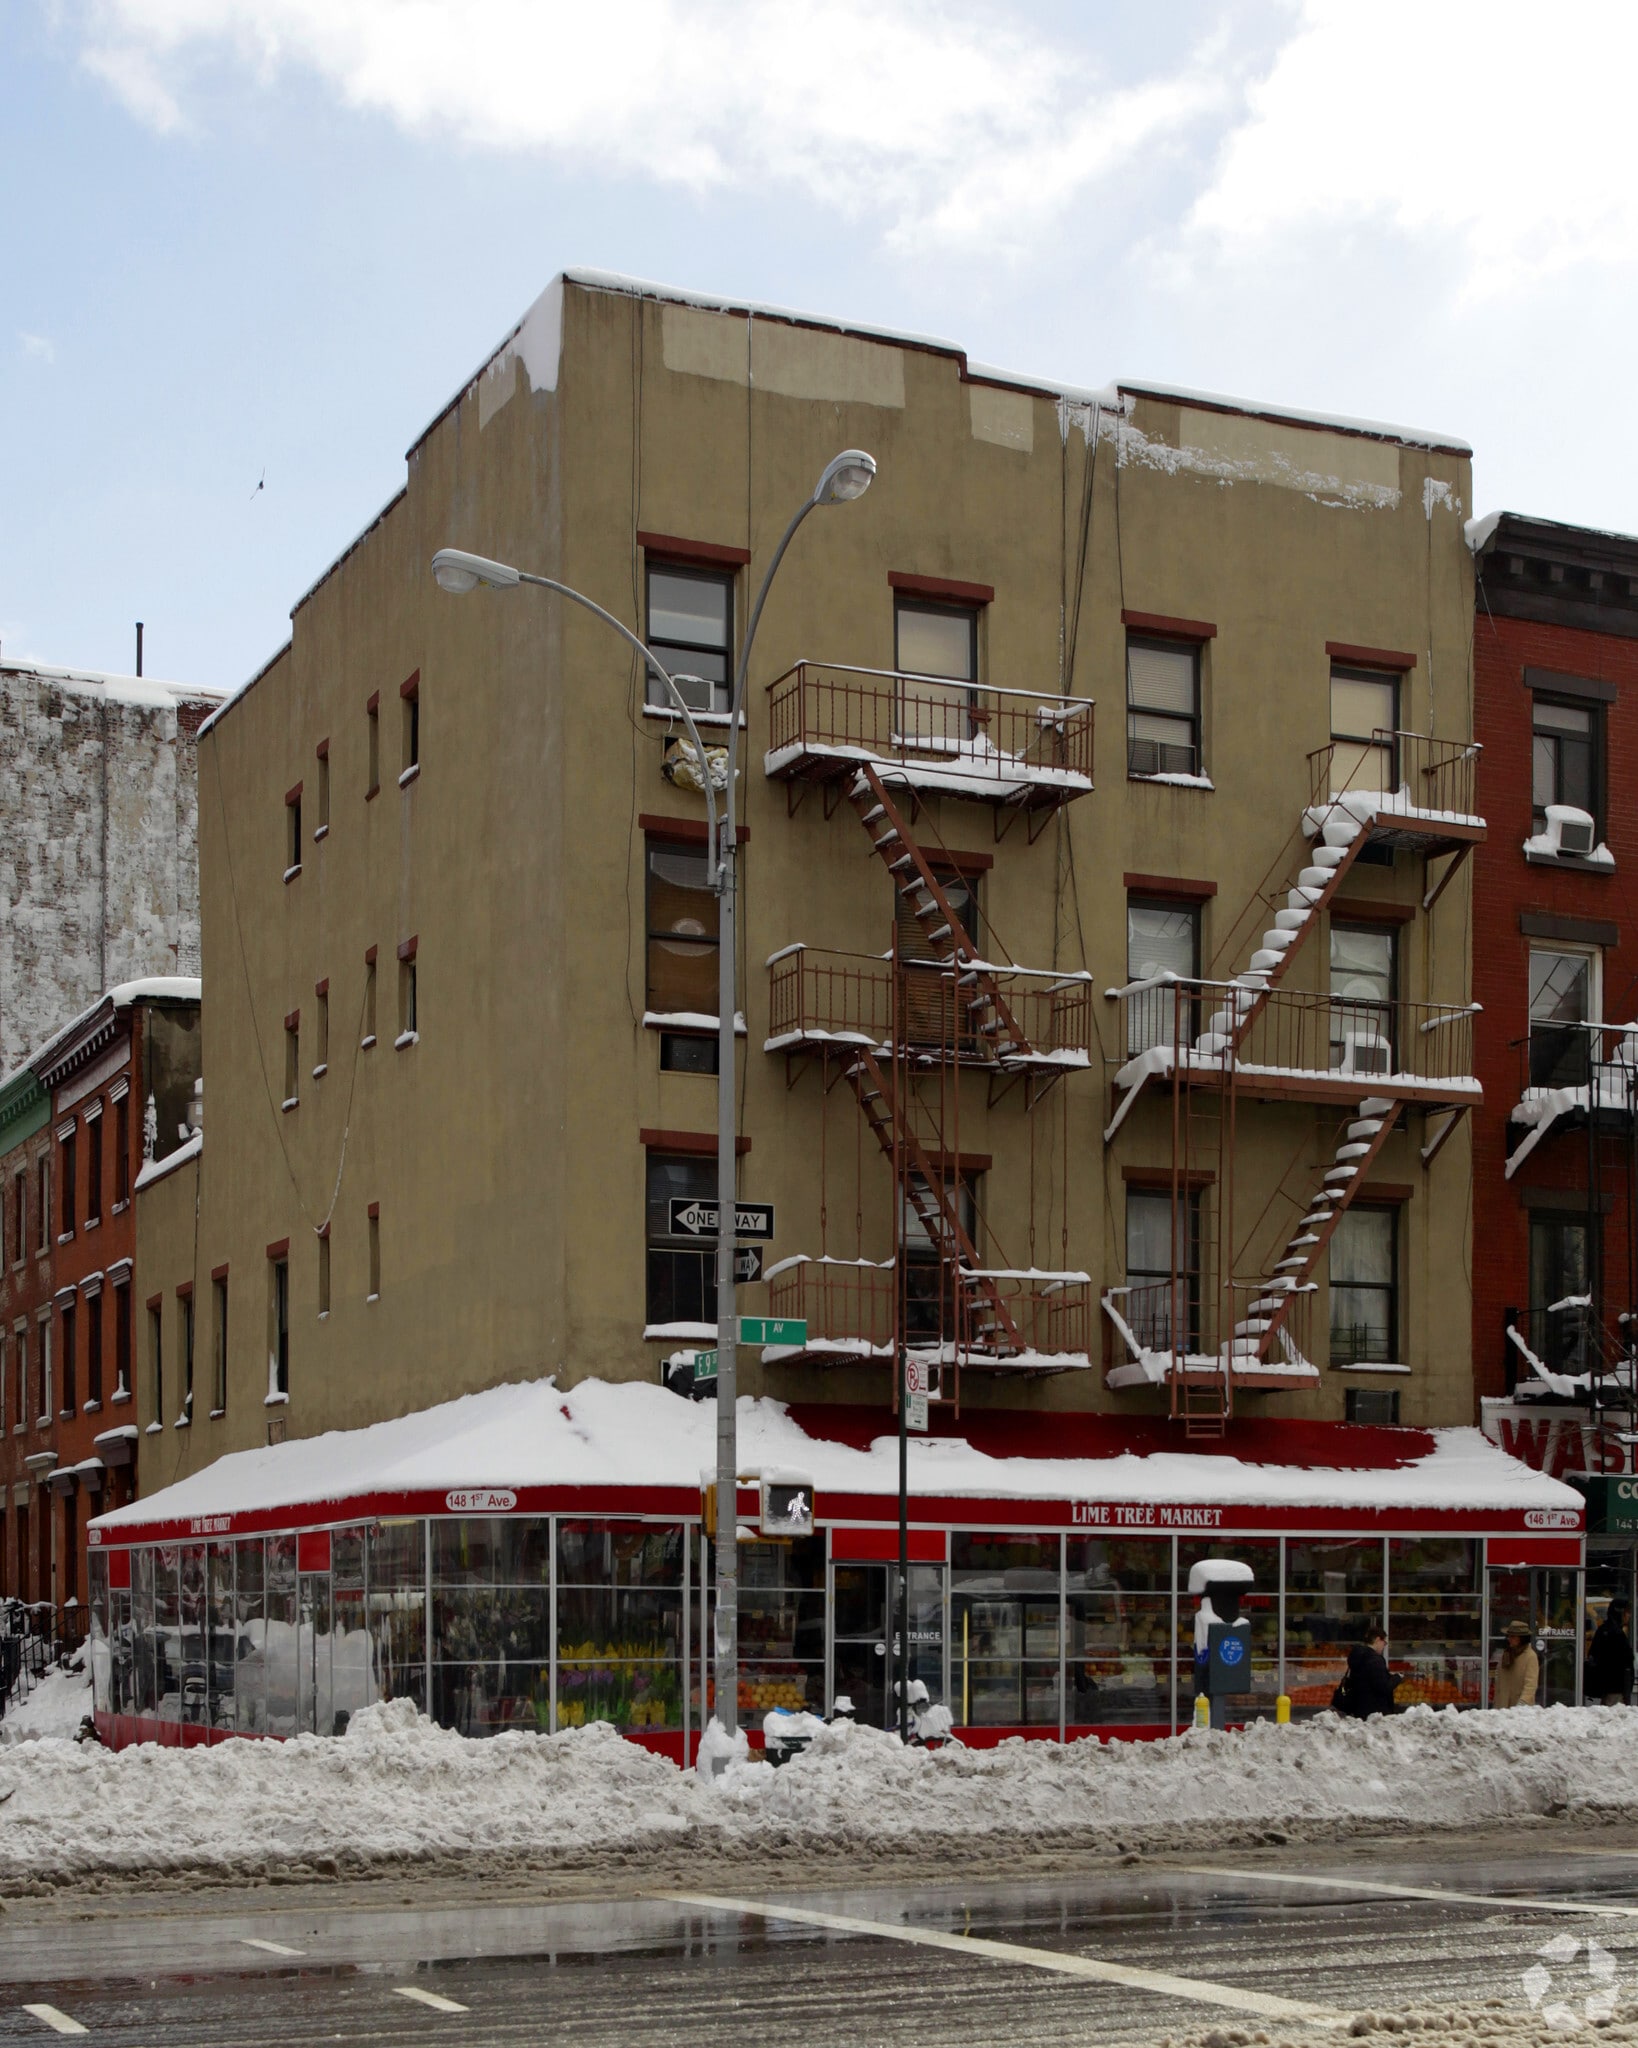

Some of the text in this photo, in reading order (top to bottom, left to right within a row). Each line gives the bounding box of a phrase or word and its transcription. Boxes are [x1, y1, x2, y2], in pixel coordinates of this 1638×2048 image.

[686, 1211, 715, 1226] ONE
[741, 1257, 755, 1272] WAY
[761, 1322, 784, 1342] 1 AV
[698, 1356, 703, 1376] E
[705, 1354, 711, 1374] 9
[1499, 1418, 1638, 1480] WAS
[449, 1494, 466, 1507] 148
[487, 1494, 513, 1507] Ave.
[1072, 1506, 1222, 1526] LIME TREE MARKET
[1529, 1513, 1544, 1525] 146
[1560, 1514, 1578, 1526] Ave.
[895, 1631, 941, 1640] ETRANCE
